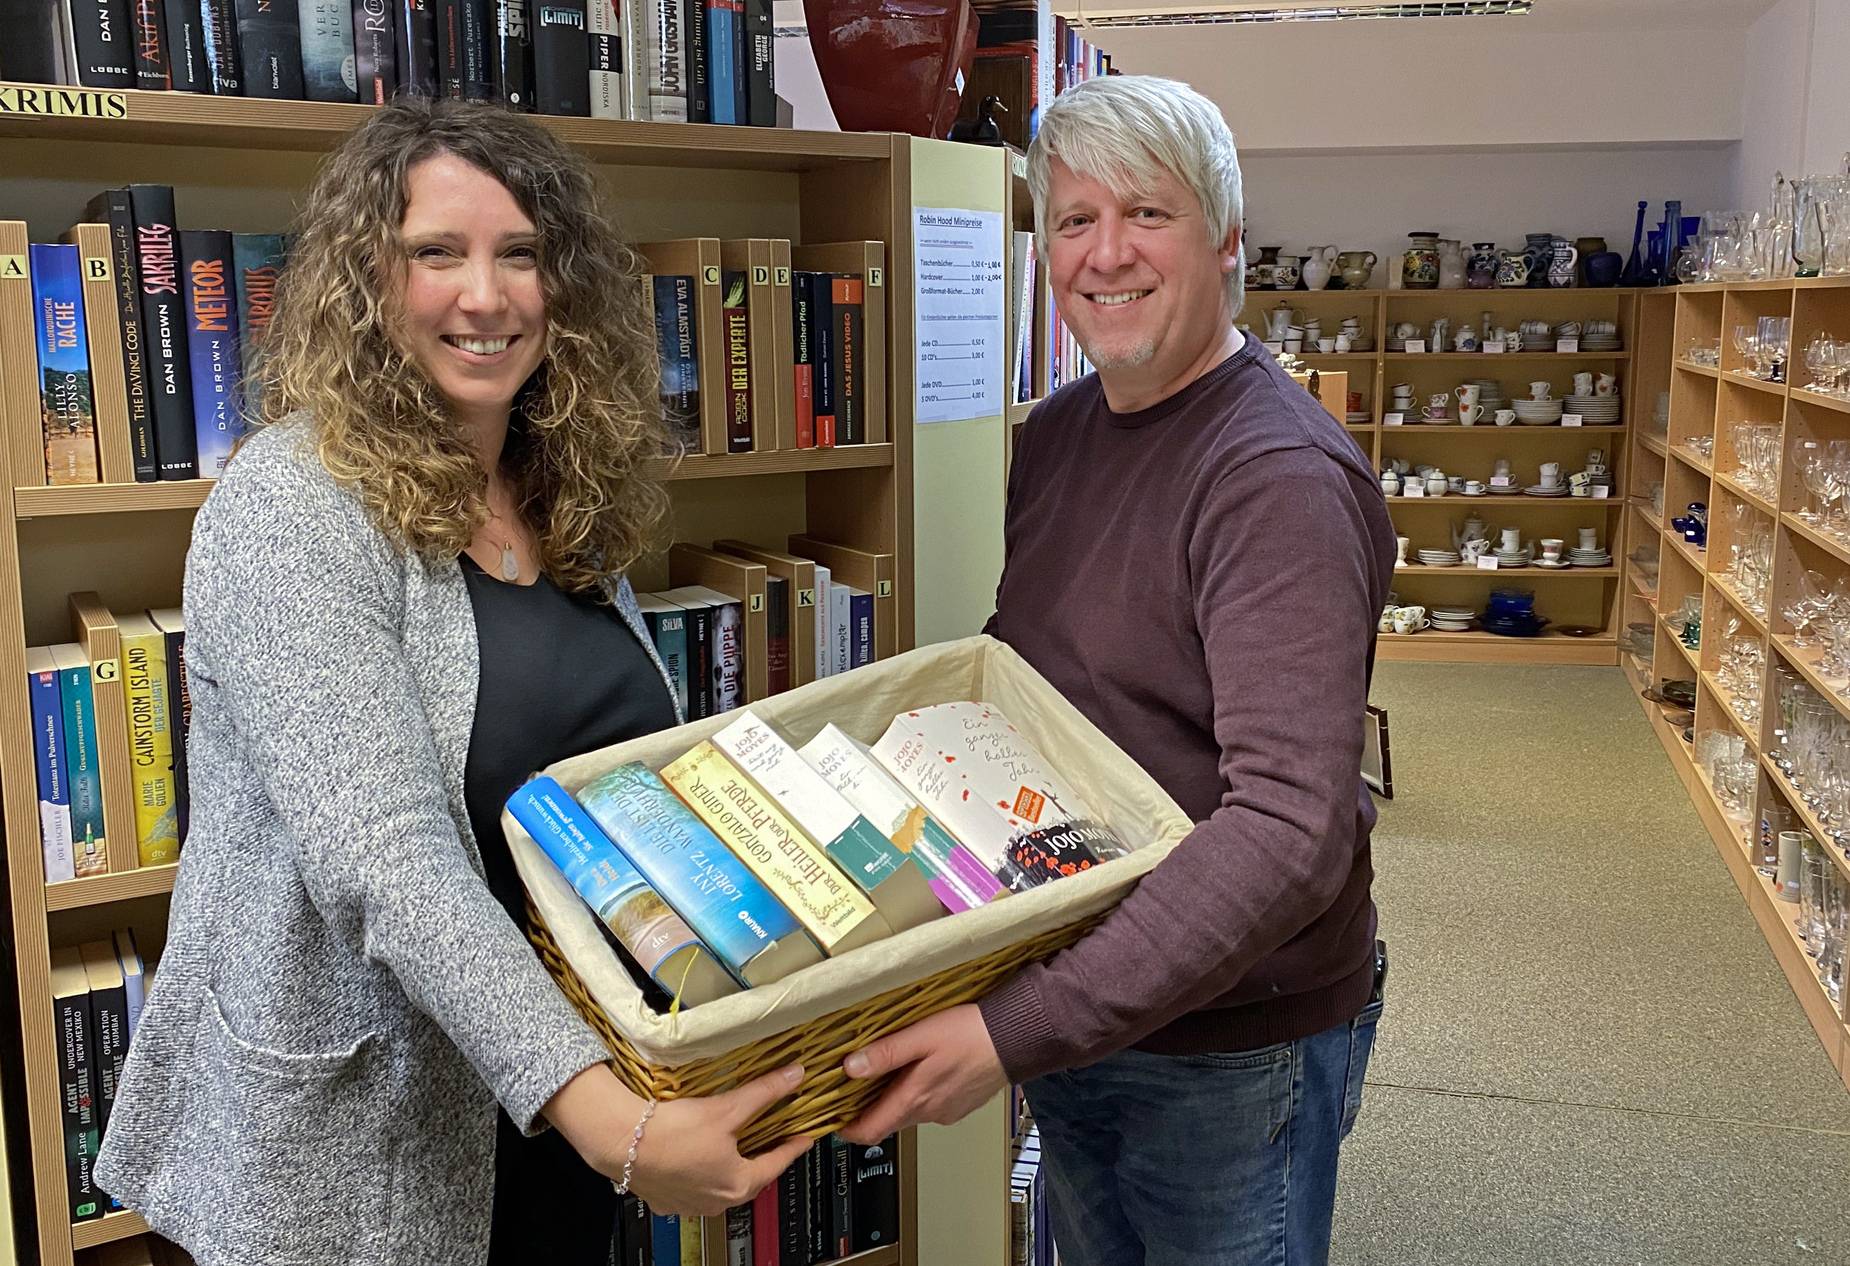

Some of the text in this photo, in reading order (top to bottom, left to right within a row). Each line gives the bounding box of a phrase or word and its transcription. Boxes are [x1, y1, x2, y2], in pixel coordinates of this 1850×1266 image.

[99, 9, 111, 42] DAN
[137, 17, 160, 64] Akif
[600, 36, 609, 70] PIPER
[271, 57, 279, 89] blanvalet
[659, 57, 680, 92] JOHN
[920, 215, 982, 228] Robin Hood Minipreise
[4, 258, 23, 275] A
[89, 260, 107, 277] B
[138, 223, 178, 295] SAKRILEG
[920, 259, 953, 267] Taschenbücher
[704, 267, 718, 283] C
[755, 268, 767, 283] D
[777, 268, 788, 283] E
[871, 269, 881, 284] F
[191, 259, 229, 331] METEOR
[55, 302, 77, 347] RACHE
[676, 279, 691, 359] EVA ALMSTÄDT
[843, 312, 852, 342] VIDEO
[125, 321, 138, 350] CODE
[159, 304, 176, 394] DAN BROWN
[730, 314, 748, 391] DER EXPERTE
[844, 344, 852, 374] JESUS
[211, 340, 226, 430] DAN BROWN
[55, 383, 67, 419] LILLY
[66, 373, 80, 428] ALONSO
[133, 399, 145, 421] THE
[752, 595, 761, 610] J
[800, 591, 812, 605] K
[880, 582, 890, 596] L
[722, 625, 735, 667] PUPPE
[96, 662, 115, 680] G
[667, 653, 679, 677] SPION
[723, 671, 735, 693] DIE
[129, 647, 154, 767] CAINSTORM ISLAND
[735, 730, 759, 751] JOJO
[736, 732, 770, 758] MOYES
[895, 740, 913, 763] JOJO
[47, 715, 61, 801] Totentanz im Pulverschnee
[819, 748, 840, 770] JOJO
[143, 780, 153, 806] MARIE
[155, 778, 166, 806] GOLIEN
[721, 779, 763, 830] PFERDE
[55, 809, 63, 845] FISCHLER
[527, 794, 588, 865] Herzlichen Glückwunsch,
[541, 794, 593, 852] Sie haben gewonnen!
[627, 811, 675, 855] DIE LIST
[689, 776, 772, 863] GONZALO GINER
[769, 819, 784, 837] DER
[1044, 830, 1084, 856] JOJO
[690, 850, 743, 901] LORENTZ
[690, 872, 718, 895] INY
[824, 874, 841, 895] DER
[744, 918, 768, 939] KNAUR
[830, 906, 856, 928] Weltbild
[652, 932, 669, 948] dtv
[64, 1006, 76, 1069] UNDERCOVER IN
[74, 1011, 84, 1062] NEW MEXIKO
[102, 1010, 111, 1055] OPERATION
[112, 1014, 120, 1048] MUMBAI
[66, 1083, 78, 1113] AGENT
[103, 1069, 114, 1100] AGENT
[78, 1132, 91, 1193] Andrew Lane
[837, 1150, 847, 1196] Glennkill
